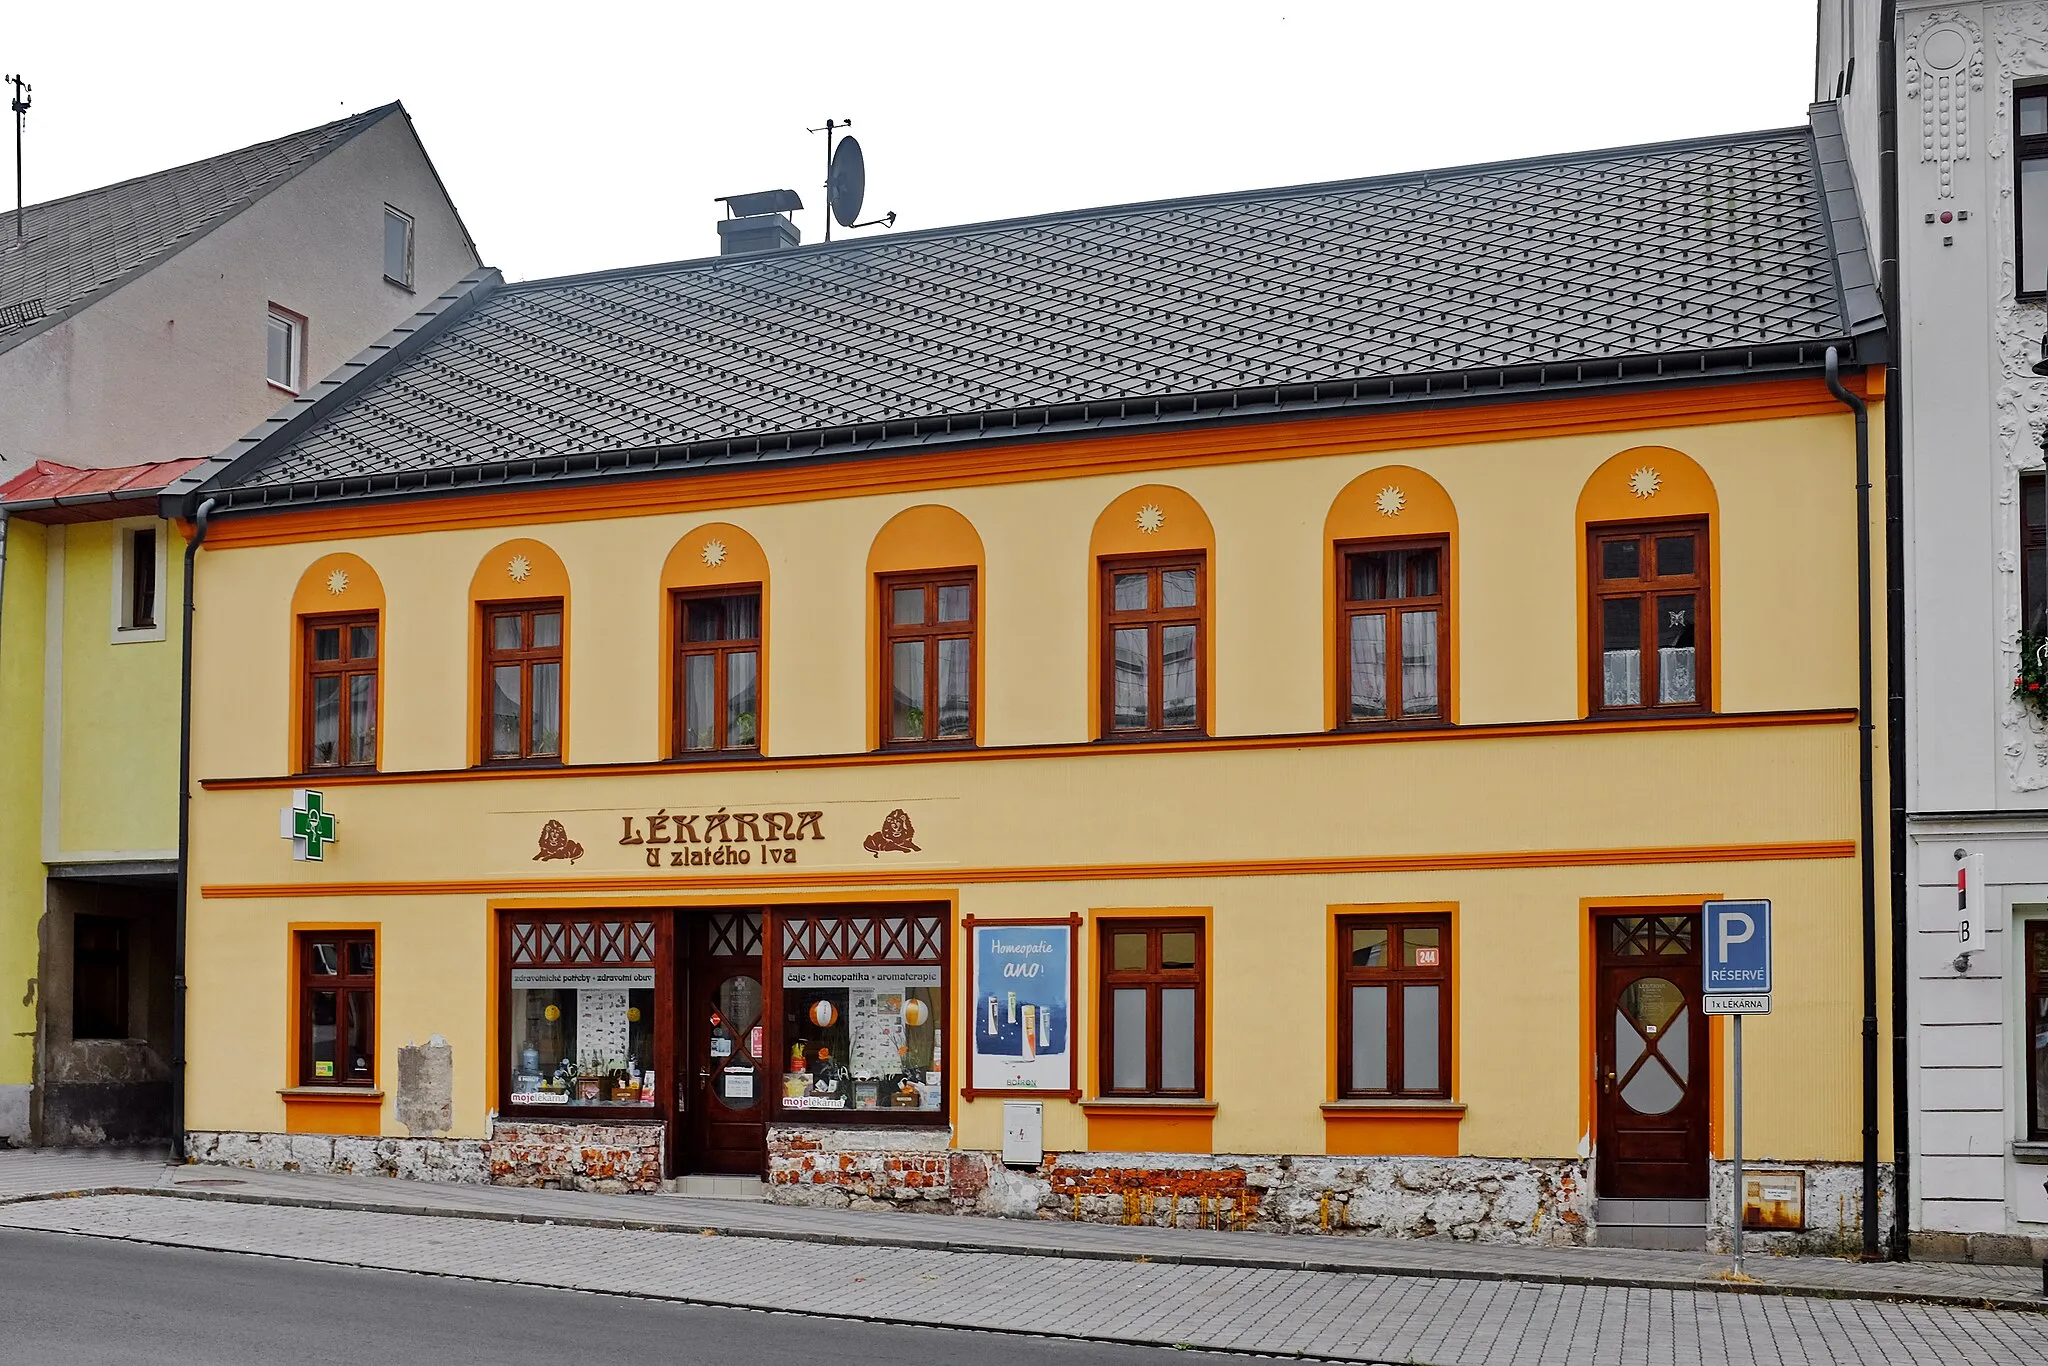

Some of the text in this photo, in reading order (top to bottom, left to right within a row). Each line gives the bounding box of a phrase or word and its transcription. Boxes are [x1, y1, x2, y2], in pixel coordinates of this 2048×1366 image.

[618, 807, 826, 845] LÉKÁRNA
[670, 845, 751, 867] zlatého
[761, 844, 797, 865] lva
[1718, 912, 1755, 963] P
[991, 938, 1054, 959] Homeopatie
[1419, 951, 1435, 963] 244
[562, 973, 591, 984] potřeby
[633, 973, 653, 982] obuv
[787, 972, 937, 983] čaje homeopatika aromaterapie
[1711, 967, 1765, 981] RÉSERVÉ
[1712, 998, 1763, 1009] 1x LÉKÁRNA
